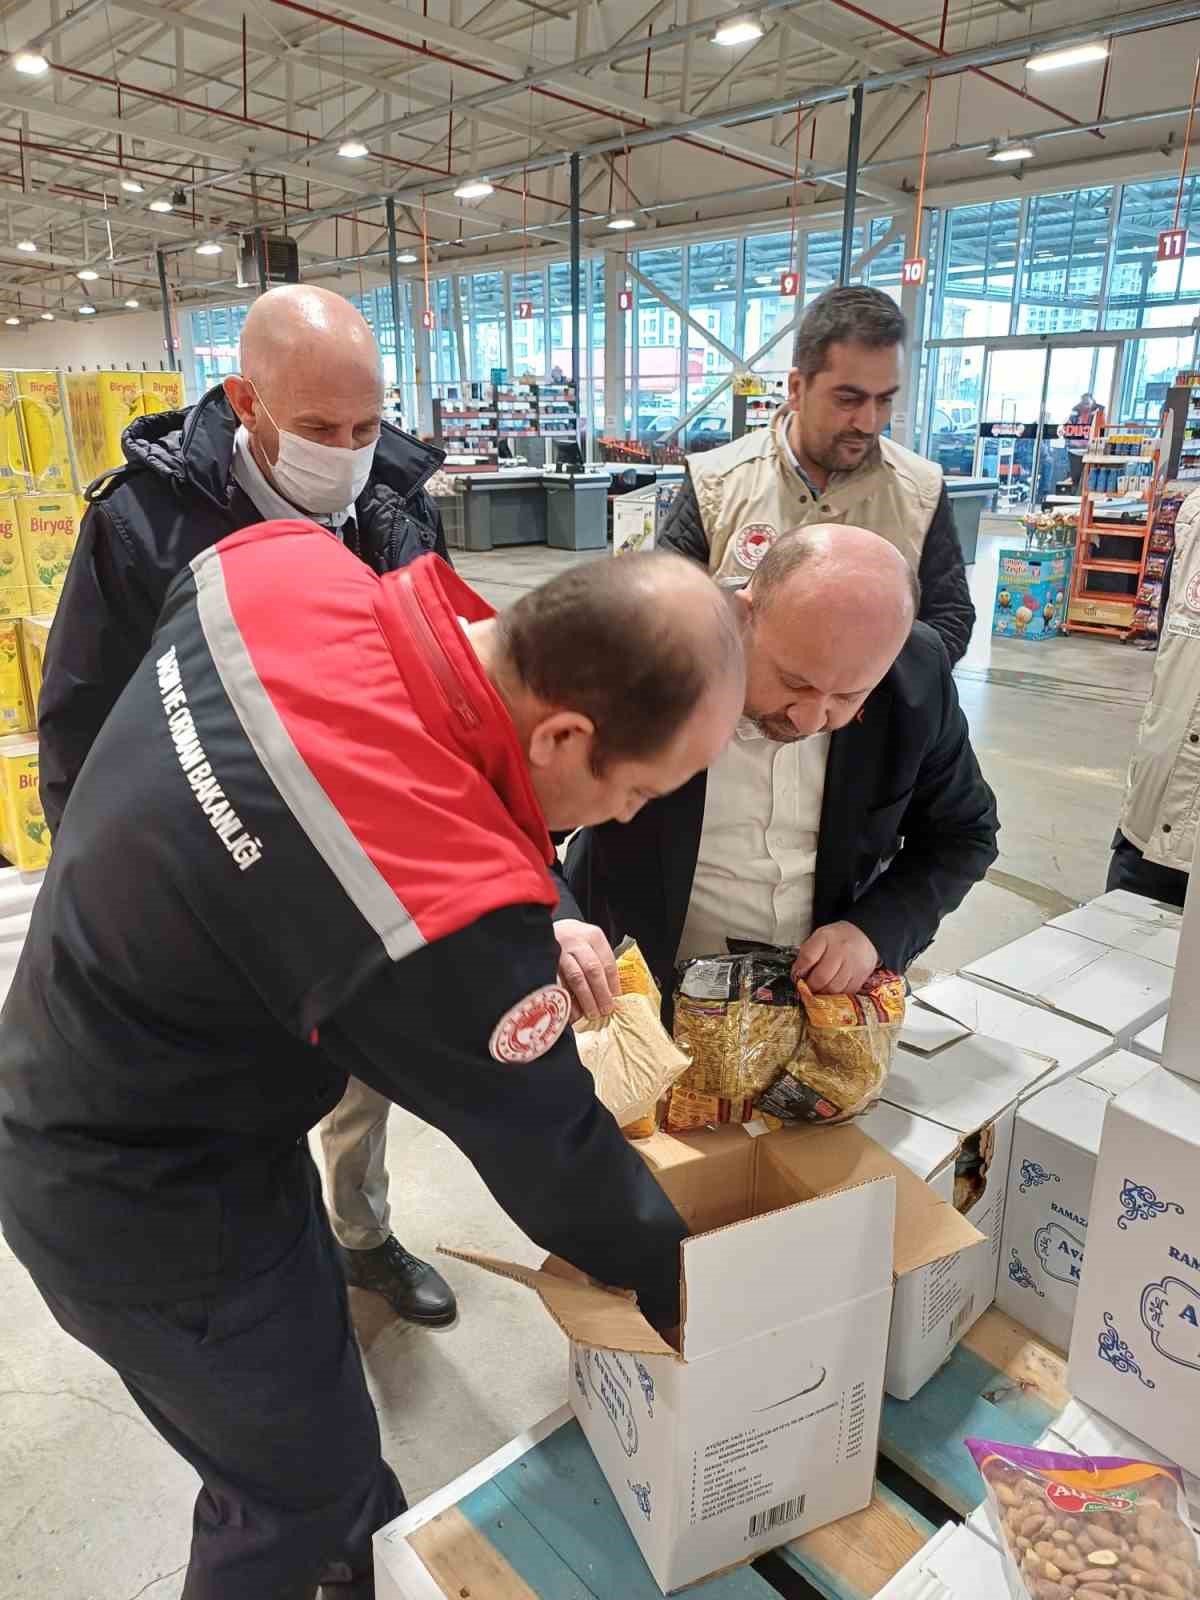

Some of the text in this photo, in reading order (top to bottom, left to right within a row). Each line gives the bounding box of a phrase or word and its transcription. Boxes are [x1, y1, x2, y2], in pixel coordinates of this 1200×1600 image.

[1163, 235, 1182, 256] 11
[904, 263, 921, 281] 10
[784, 277, 794, 294] 9
[521, 303, 529, 317] 7
[31, 517, 74, 535] Biryağ
[162, 683, 188, 716] VE
[186, 760, 263, 872] BAKANLIĞI
